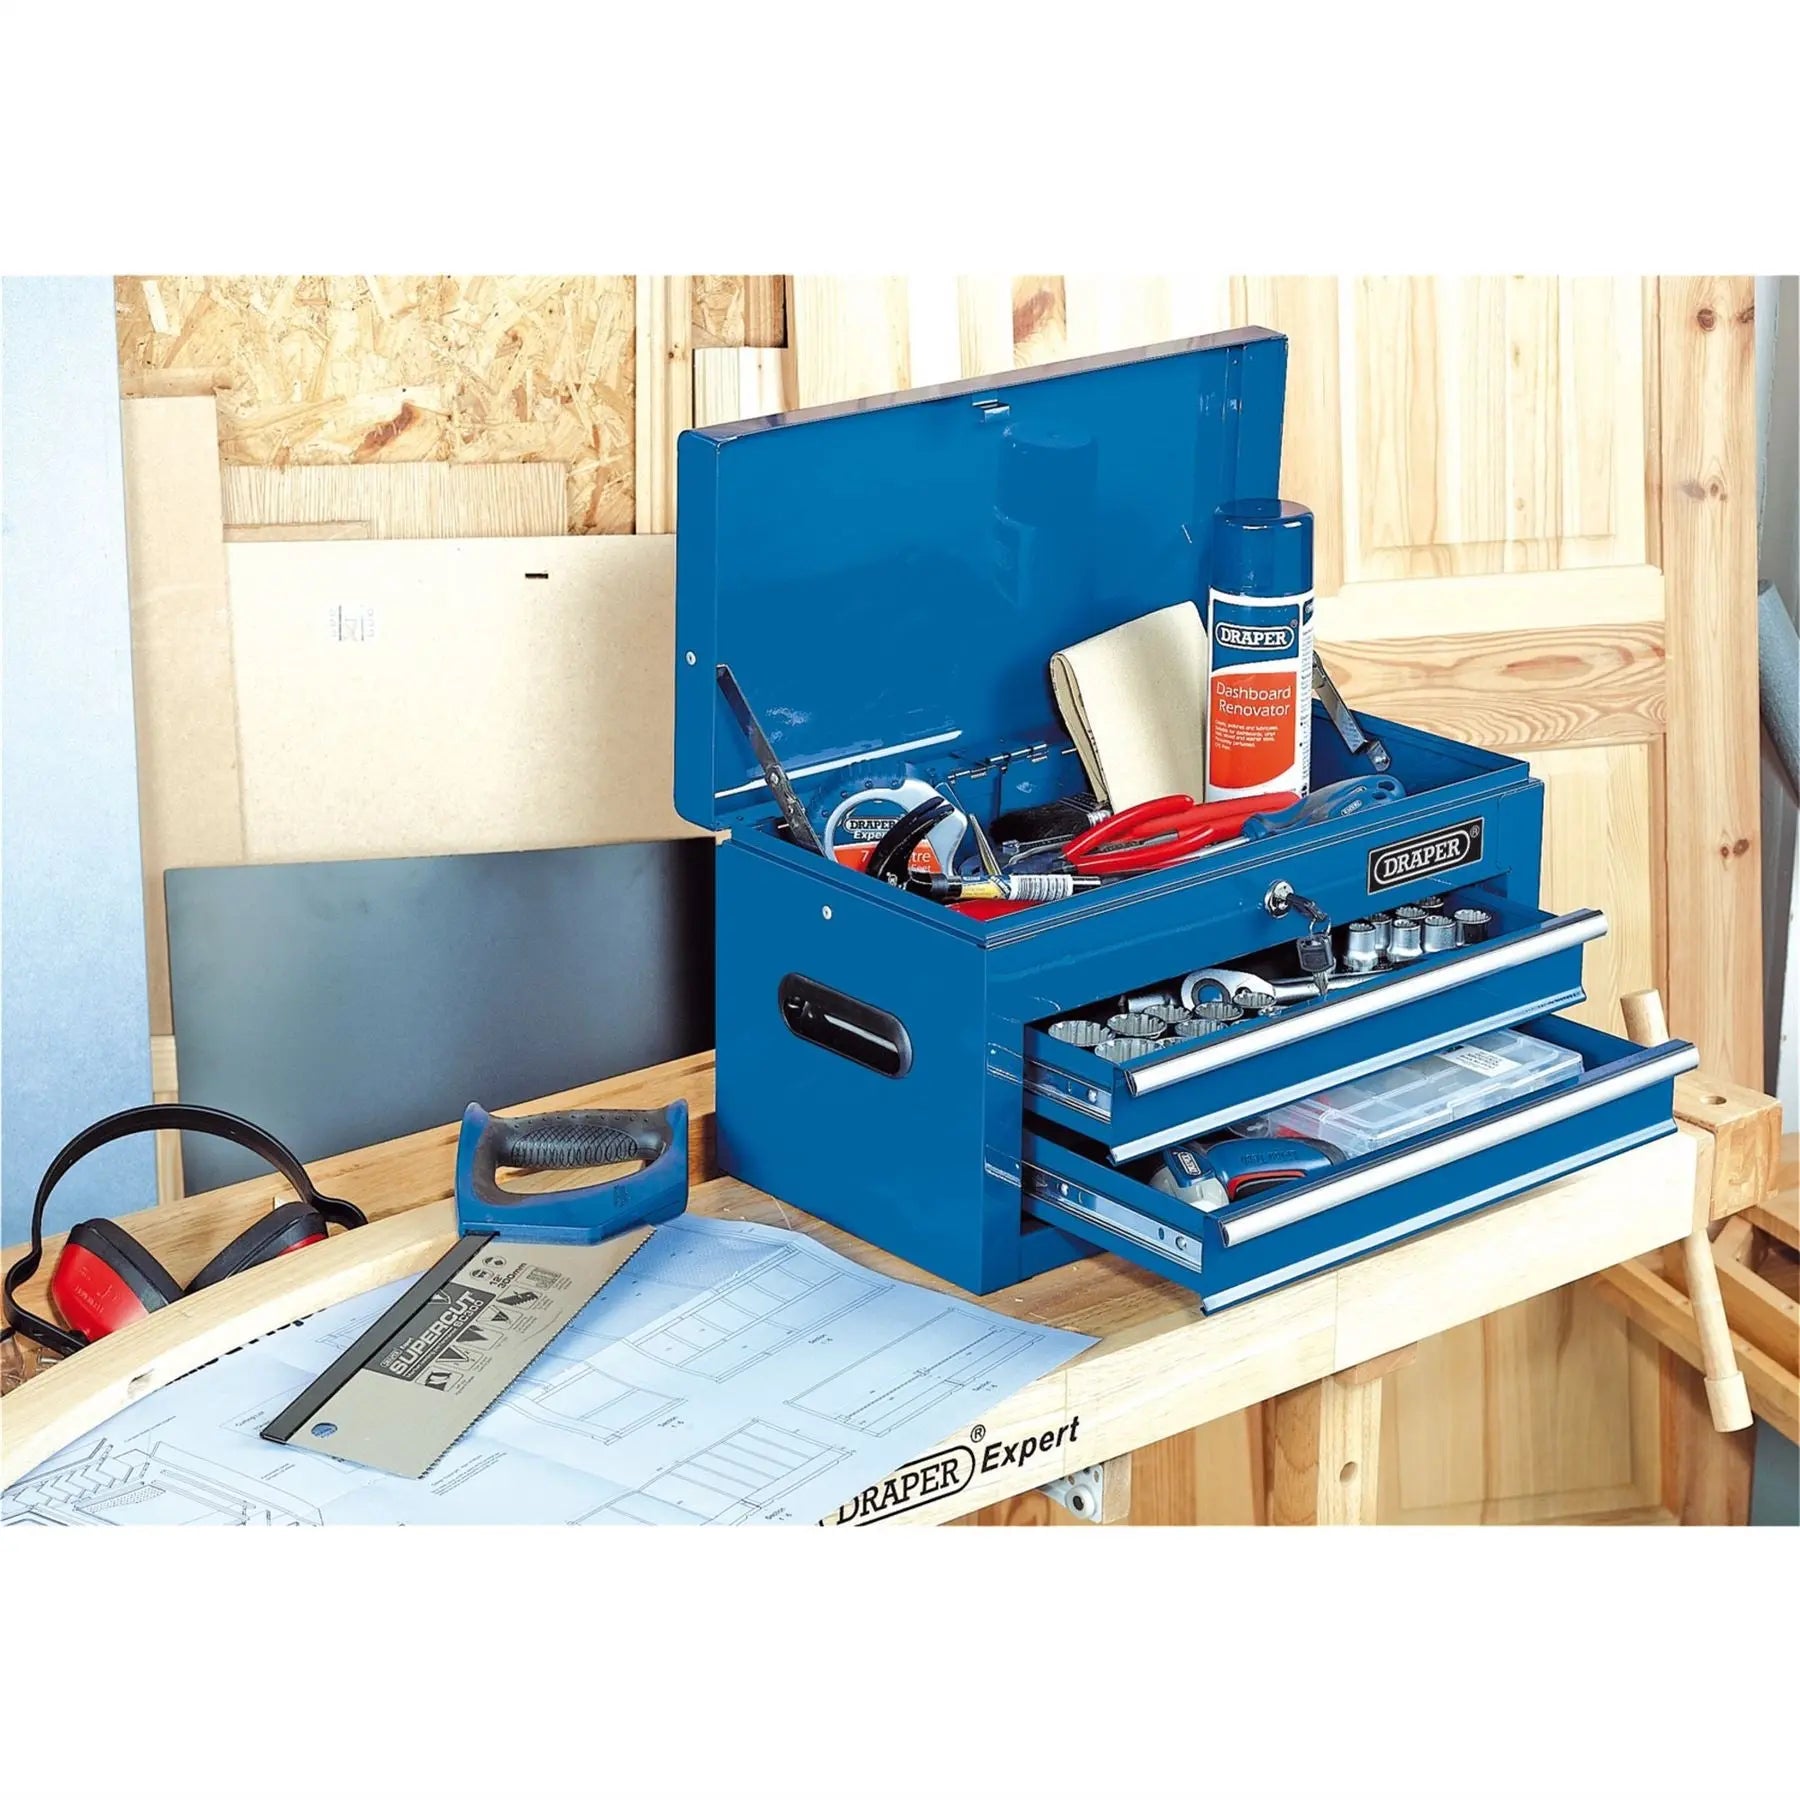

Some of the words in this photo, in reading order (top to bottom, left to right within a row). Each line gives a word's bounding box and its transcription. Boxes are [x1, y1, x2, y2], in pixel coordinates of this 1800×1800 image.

[1220, 627, 1287, 646] DRAPER
[1216, 681, 1292, 701] Dashboard
[1219, 699, 1290, 717] Renovator
[853, 830, 887, 841] Exper
[1383, 837, 1461, 878] DRAPER
[497, 1262, 527, 1288] 300mm
[453, 1300, 484, 1328] SC300
[389, 1291, 475, 1375] SUPERCUT
[836, 1458, 960, 1526] DRAPER
[981, 1416, 1080, 1474] Expert
